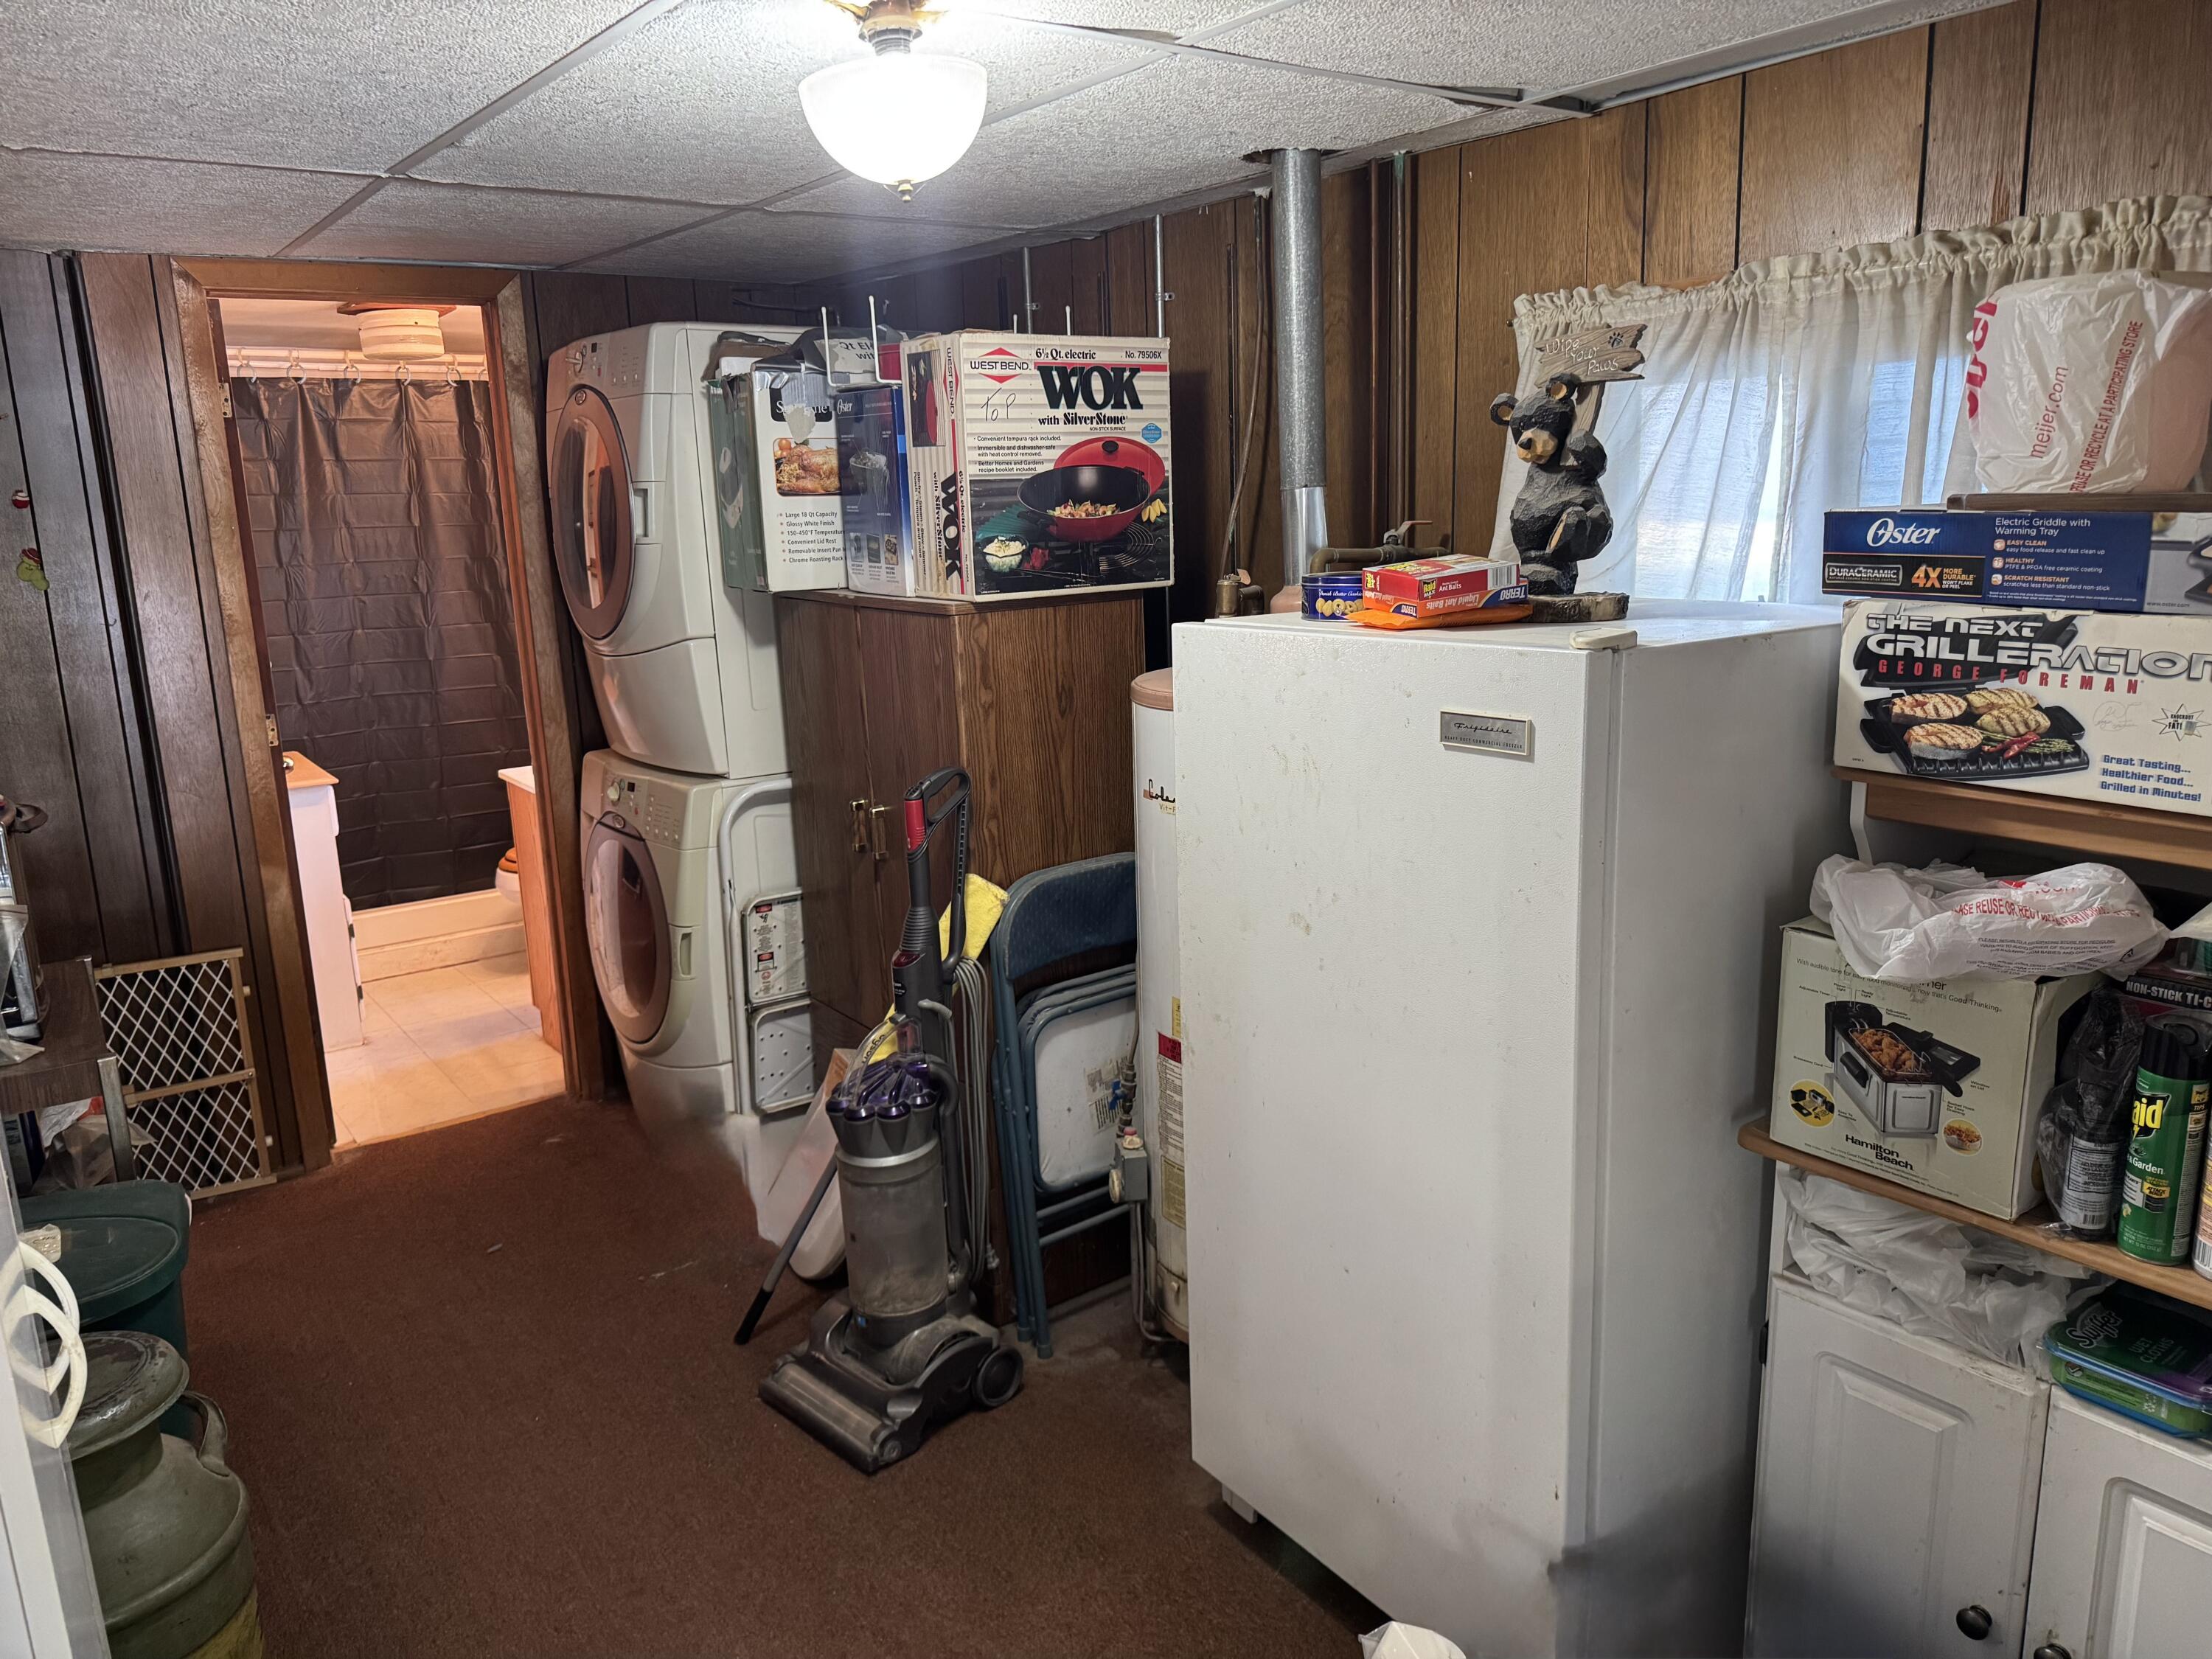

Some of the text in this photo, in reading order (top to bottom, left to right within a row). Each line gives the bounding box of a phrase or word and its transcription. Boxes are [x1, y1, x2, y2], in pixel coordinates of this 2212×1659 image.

[1050, 348, 1063, 360] Qt.
[1065, 349, 1096, 359] electric
[1137, 351, 1162, 359] 79506X
[1545, 338, 1579, 358] Wipe
[970, 361, 1029, 370] WEST BEND
[1587, 358, 1618, 375] Paws
[1037, 366, 1144, 410] WOK
[2079, 320, 2143, 473] OR RECYCLE AT PARTICIPATING STORE
[837, 398, 852, 414] Oster
[2028, 366, 2069, 459] meijer.com
[1038, 413, 1126, 425] with SilverStone
[940, 472, 962, 581] WOK
[1995, 518, 2031, 526] Electric
[2032, 518, 2067, 526] Griddle
[1866, 518, 1941, 547] Oster
[1995, 526, 2059, 537] Warming Tray
[1911, 564, 1941, 588] 4X
[1423, 581, 1436, 593] Raid
[1439, 584, 1448, 592] Ant
[1500, 587, 1525, 600] TERRO
[1401, 603, 1416, 616] TERRO
[1426, 594, 1479, 610] Liquid Ant Baits
[1878, 659, 2138, 695] GEORGE FOREMAN
[1454, 723, 1513, 734] Frigidaire
[1472, 738, 1501, 746] COMMERCIAL
[2103, 755, 2135, 767] Great
[2101, 768, 2154, 782] Healthier
[2101, 781, 2202, 802] Grilled in Minutes!
[1976, 898, 2018, 917] REUSE OR
[1796, 958, 1809, 967] With
[1809, 961, 1829, 972] audible
[1830, 967, 1843, 975] tone
[1917, 988, 1931, 996] now
[1948, 994, 1967, 1004] Good
[1969, 998, 2000, 1013] Thinking
[2126, 981, 2183, 1003] NON-STICK
[2131, 1097, 2164, 1130] aid
[1845, 1134, 1899, 1158] Hamilton
[1875, 1152, 1914, 1171] Beach
[2132, 1157, 2163, 1175] Garden
[2066, 1310, 2124, 1349] Swiffer
[2140, 1338, 2175, 1363] CLOTHS
